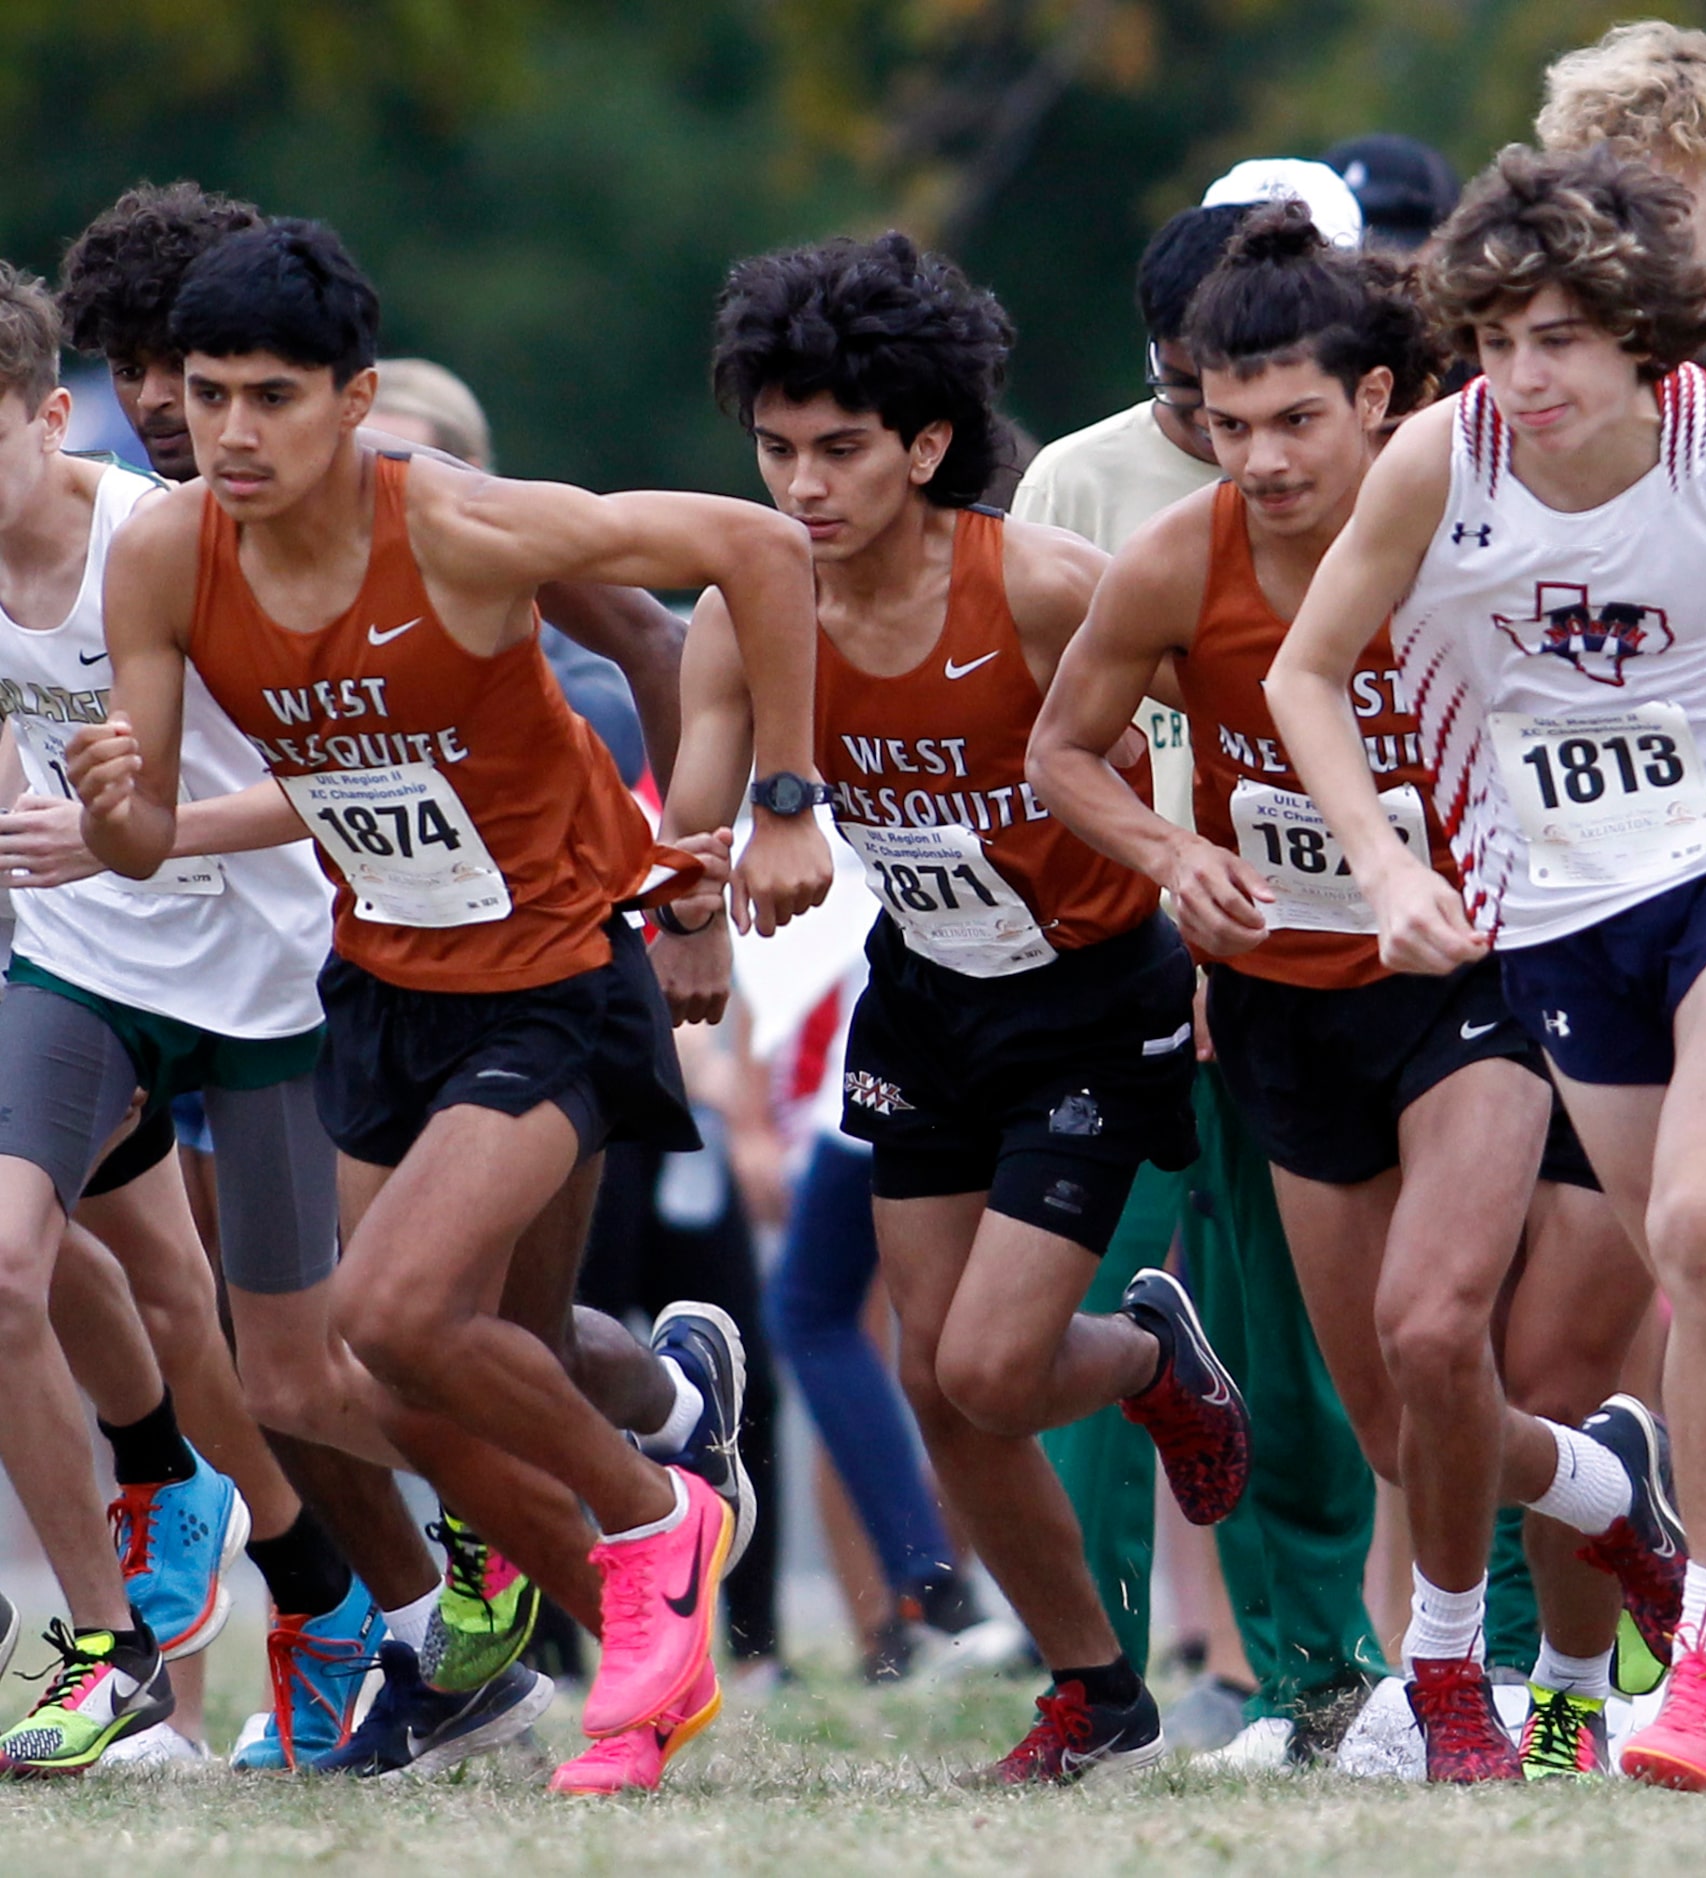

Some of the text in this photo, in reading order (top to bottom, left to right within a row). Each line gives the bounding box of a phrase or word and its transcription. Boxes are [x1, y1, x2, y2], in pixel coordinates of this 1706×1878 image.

[262, 677, 389, 726] WEST
[840, 735, 969, 777] WEST
[316, 768, 403, 785] UIL Region II
[1522, 733, 1686, 810] 1813
[309, 782, 428, 801] XC Championship
[1274, 794, 1302, 808] UIL
[1257, 804, 1279, 818] XC
[317, 798, 462, 859] 1874
[889, 833, 928, 845] Region
[932, 832, 942, 843] II
[880, 846, 963, 860] Championship
[1252, 821, 1410, 877] 18
[871, 860, 999, 913] 1871
